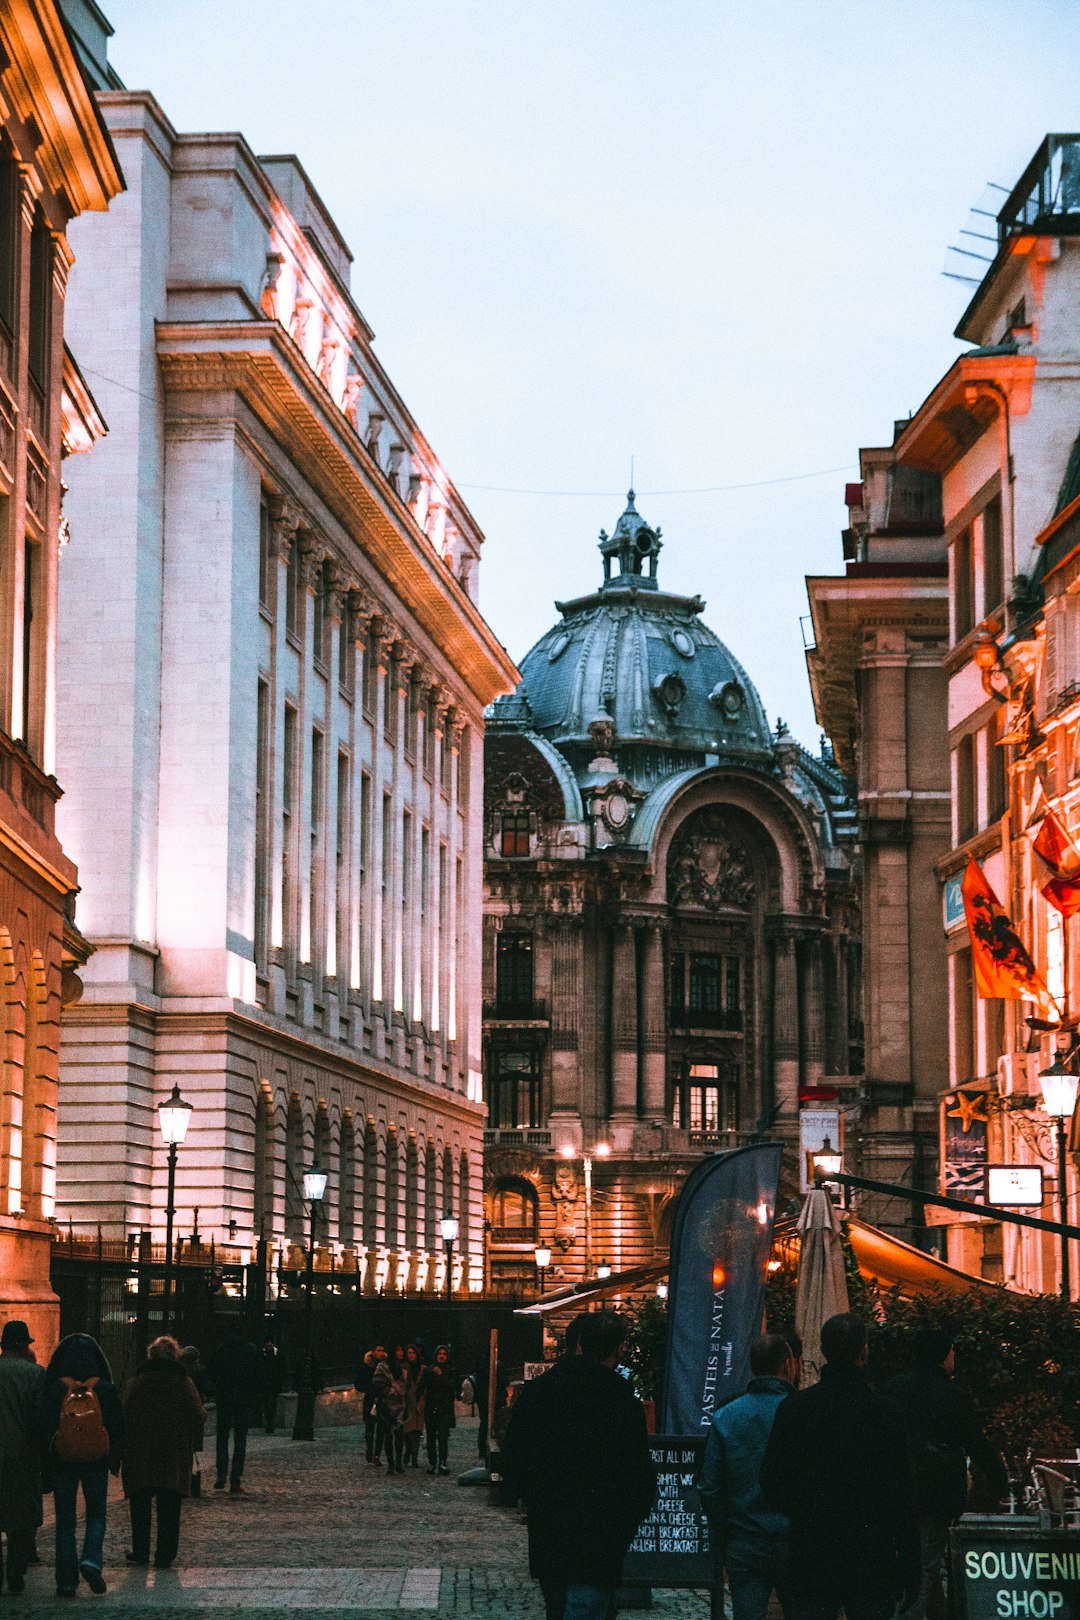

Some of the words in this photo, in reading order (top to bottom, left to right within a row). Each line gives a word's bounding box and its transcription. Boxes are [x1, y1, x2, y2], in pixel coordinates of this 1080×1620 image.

[701, 1356, 719, 1426] PASTEIS
[711, 1289, 725, 1339] NATA
[667, 1450, 679, 1464] ALL
[682, 1451, 695, 1464] DAY
[659, 1487, 679, 1498] WITH
[658, 1499, 685, 1512] CHEESE
[669, 1514, 696, 1527] CHEESE
[660, 1527, 699, 1539] BREAKFAST
[660, 1540, 700, 1553] BREAKFAST
[996, 1589, 1064, 1618] SHOP
